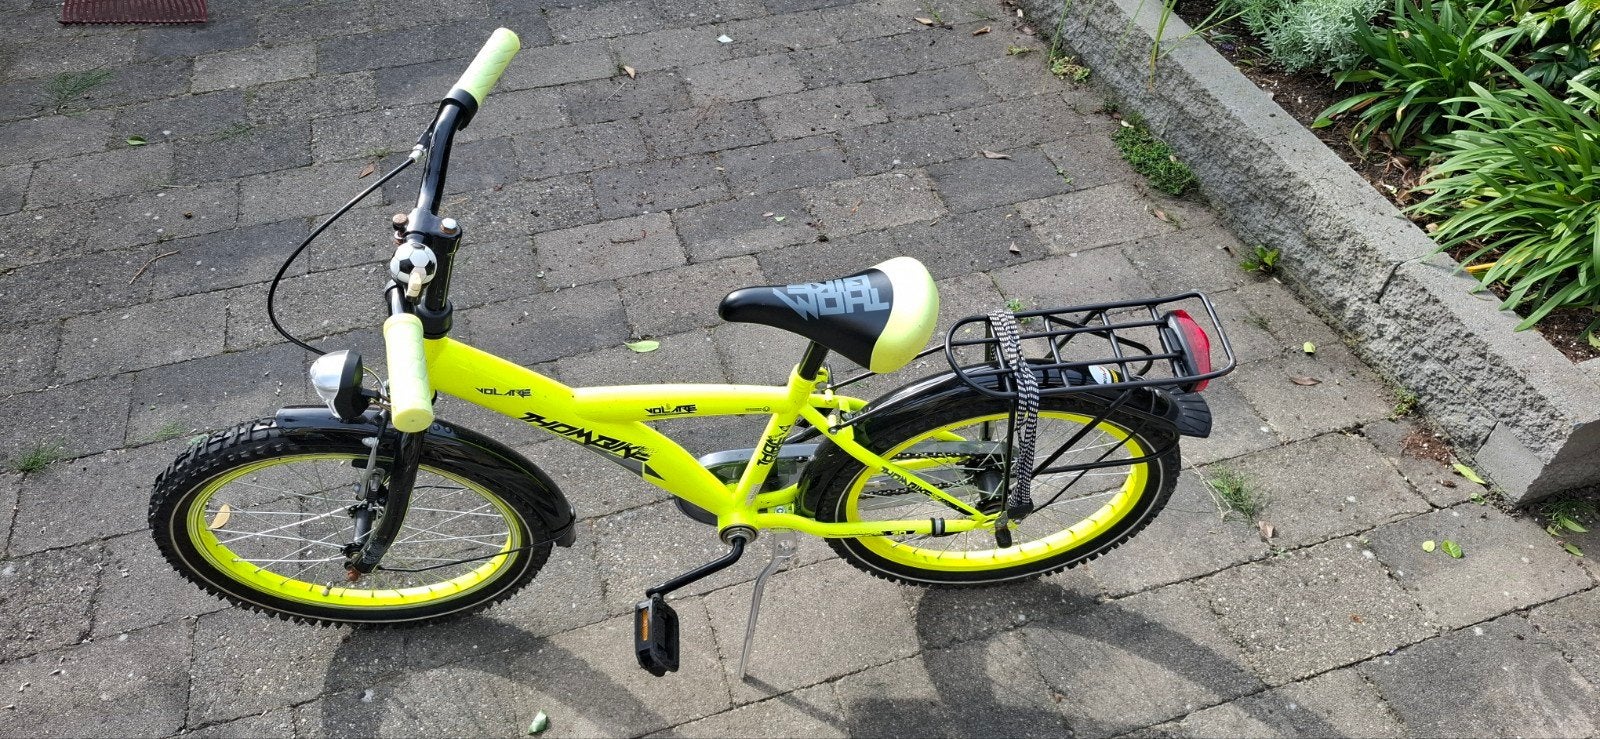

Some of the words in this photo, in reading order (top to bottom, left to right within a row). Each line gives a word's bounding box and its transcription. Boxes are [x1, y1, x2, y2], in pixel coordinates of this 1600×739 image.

[787, 274, 872, 298] BIKE
[773, 288, 889, 321] THOM
[475, 387, 532, 398] VOLARE
[645, 404, 697, 414] VOLARE
